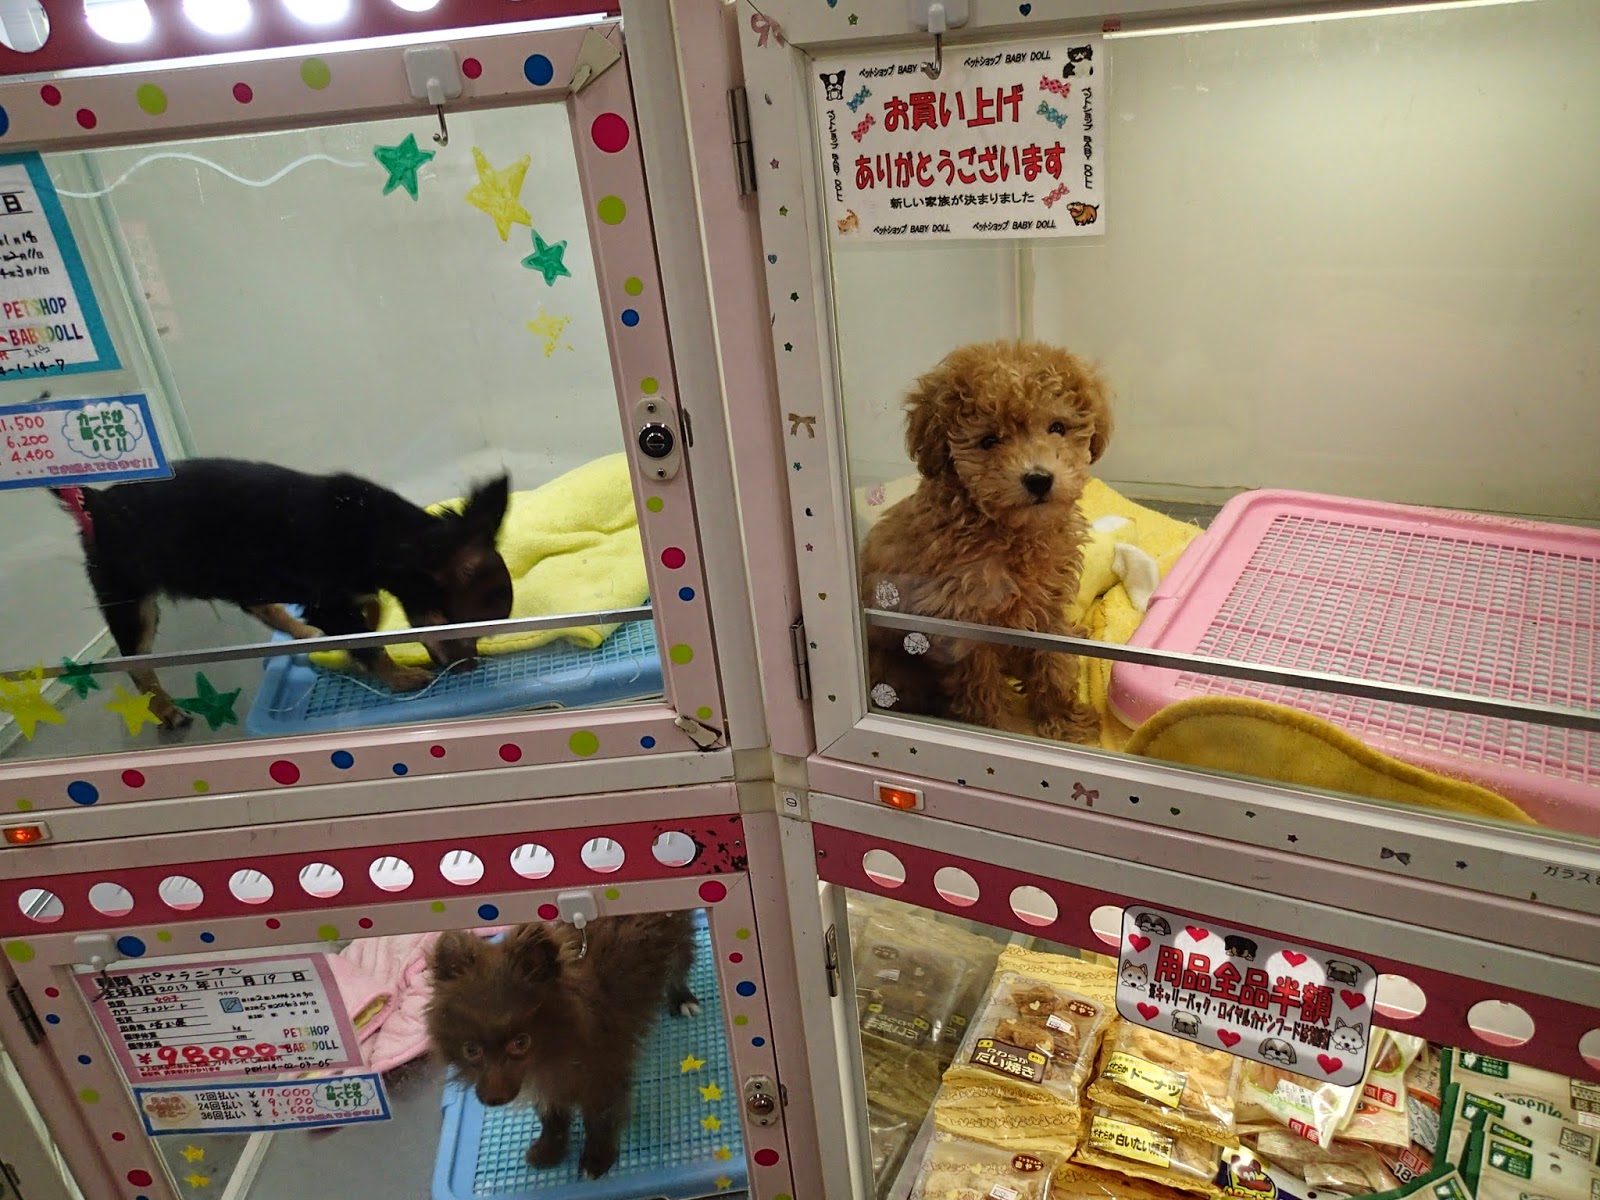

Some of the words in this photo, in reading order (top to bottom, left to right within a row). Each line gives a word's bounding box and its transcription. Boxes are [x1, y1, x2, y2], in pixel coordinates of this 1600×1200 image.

[964, 53, 1002, 68] ペットショップ
[1005, 52, 1027, 63] BABY
[1030, 50, 1051, 61] DOLL
[859, 64, 895, 78] ペットショップ
[897, 64, 917, 74] BABY
[883, 83, 1024, 132] お買い上げ
[1083, 135, 1092, 160] BABY
[855, 141, 1066, 190] ありがとうございます
[1084, 164, 1093, 190] DOLL
[835, 179, 843, 202] DOLL
[890, 191, 1035, 209] 新しい家族が決まりました
[2, 194, 23, 213] 日
[873, 224, 907, 236] ペットショップ
[910, 224, 929, 234] BABY
[932, 223, 950, 234] DOLL
[972, 221, 1009, 232] ペットショップ
[1012, 220, 1033, 231] BABY
[1036, 219, 1056, 229] DOLL
[158, 983, 189, 993] 2013
[242, 975, 256, 986] 月
[263, 973, 276, 985] 19
[292, 971, 306, 982] 日
[1154, 944, 1335, 1027] 用品全品半額
[986, 1047, 1029, 1064] やわらか
[976, 1052, 1035, 1079] たい焼き
[1131, 1067, 1181, 1096] ドーナツ
[195, 1091, 240, 1101] 12回払い
[198, 1101, 243, 1111] 24回払い
[201, 1110, 246, 1120] 36回払い
